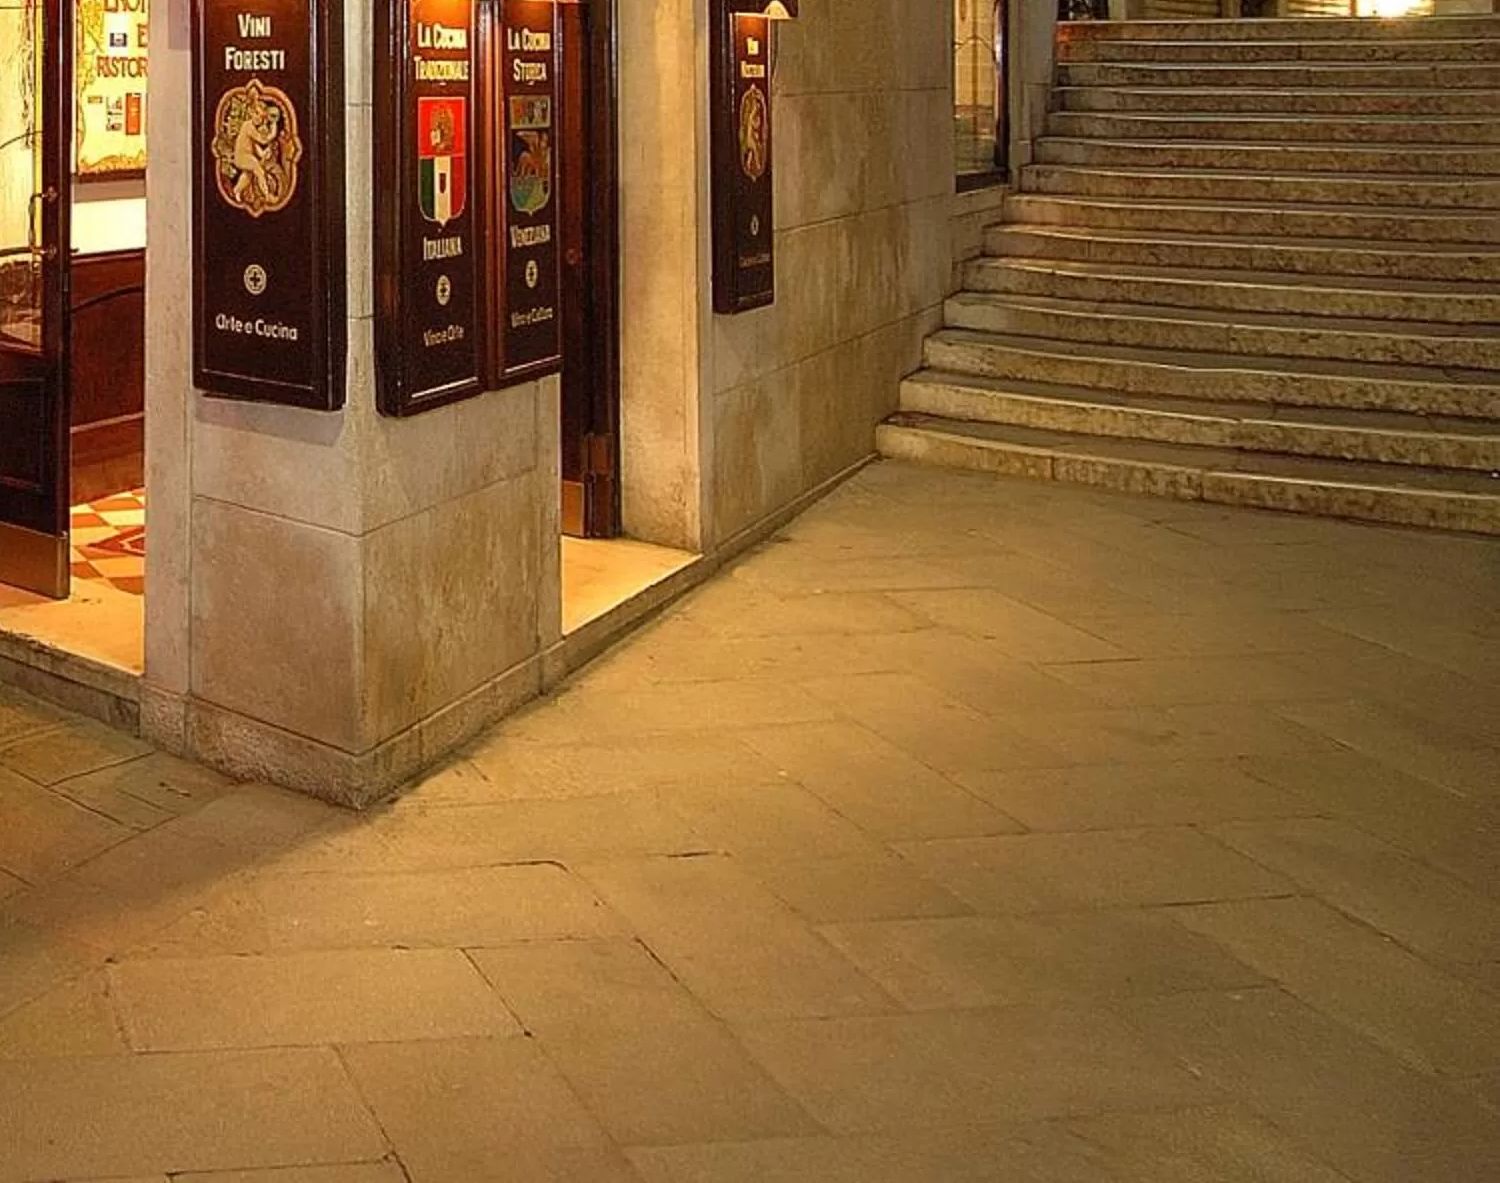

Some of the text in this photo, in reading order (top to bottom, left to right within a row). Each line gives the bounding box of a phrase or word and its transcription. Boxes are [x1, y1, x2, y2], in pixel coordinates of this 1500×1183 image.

[238, 13, 271, 38] VINI
[225, 46, 285, 70] FORESTI
[423, 236, 462, 261] ITALIANA
[244, 321, 253, 334] e
[255, 319, 298, 340] Cucina
